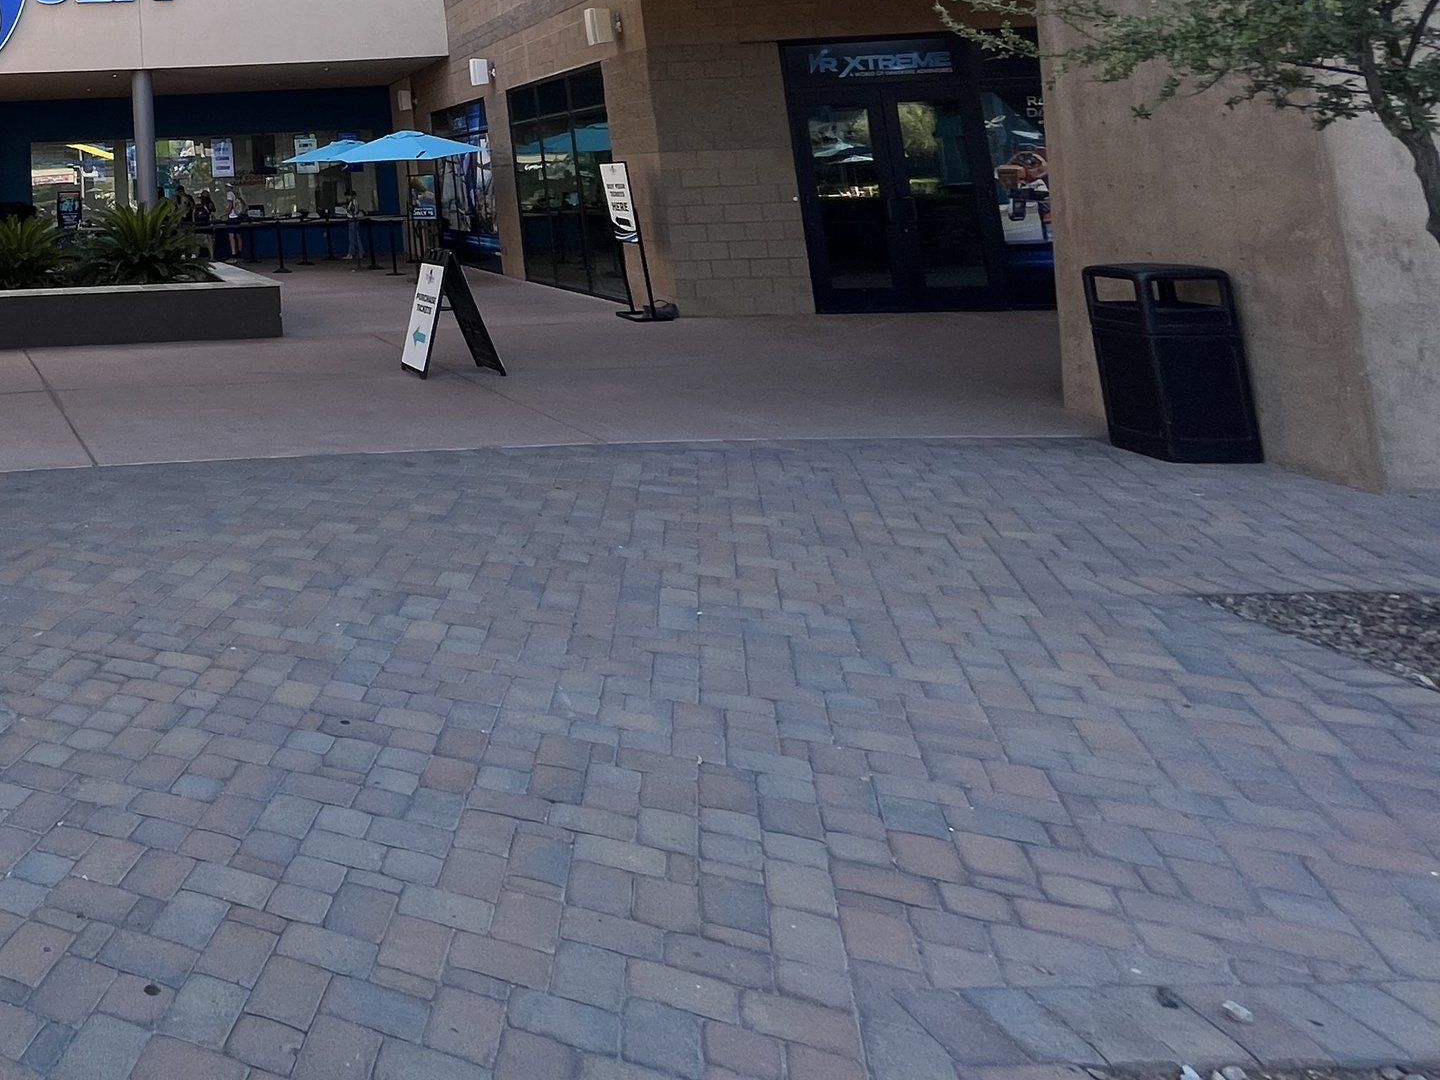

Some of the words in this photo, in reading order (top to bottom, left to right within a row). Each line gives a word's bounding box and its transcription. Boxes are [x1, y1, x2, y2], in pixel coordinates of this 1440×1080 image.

[808, 49, 839, 75] VR
[837, 51, 953, 78] XTREME
[611, 202, 629, 212] HERE
